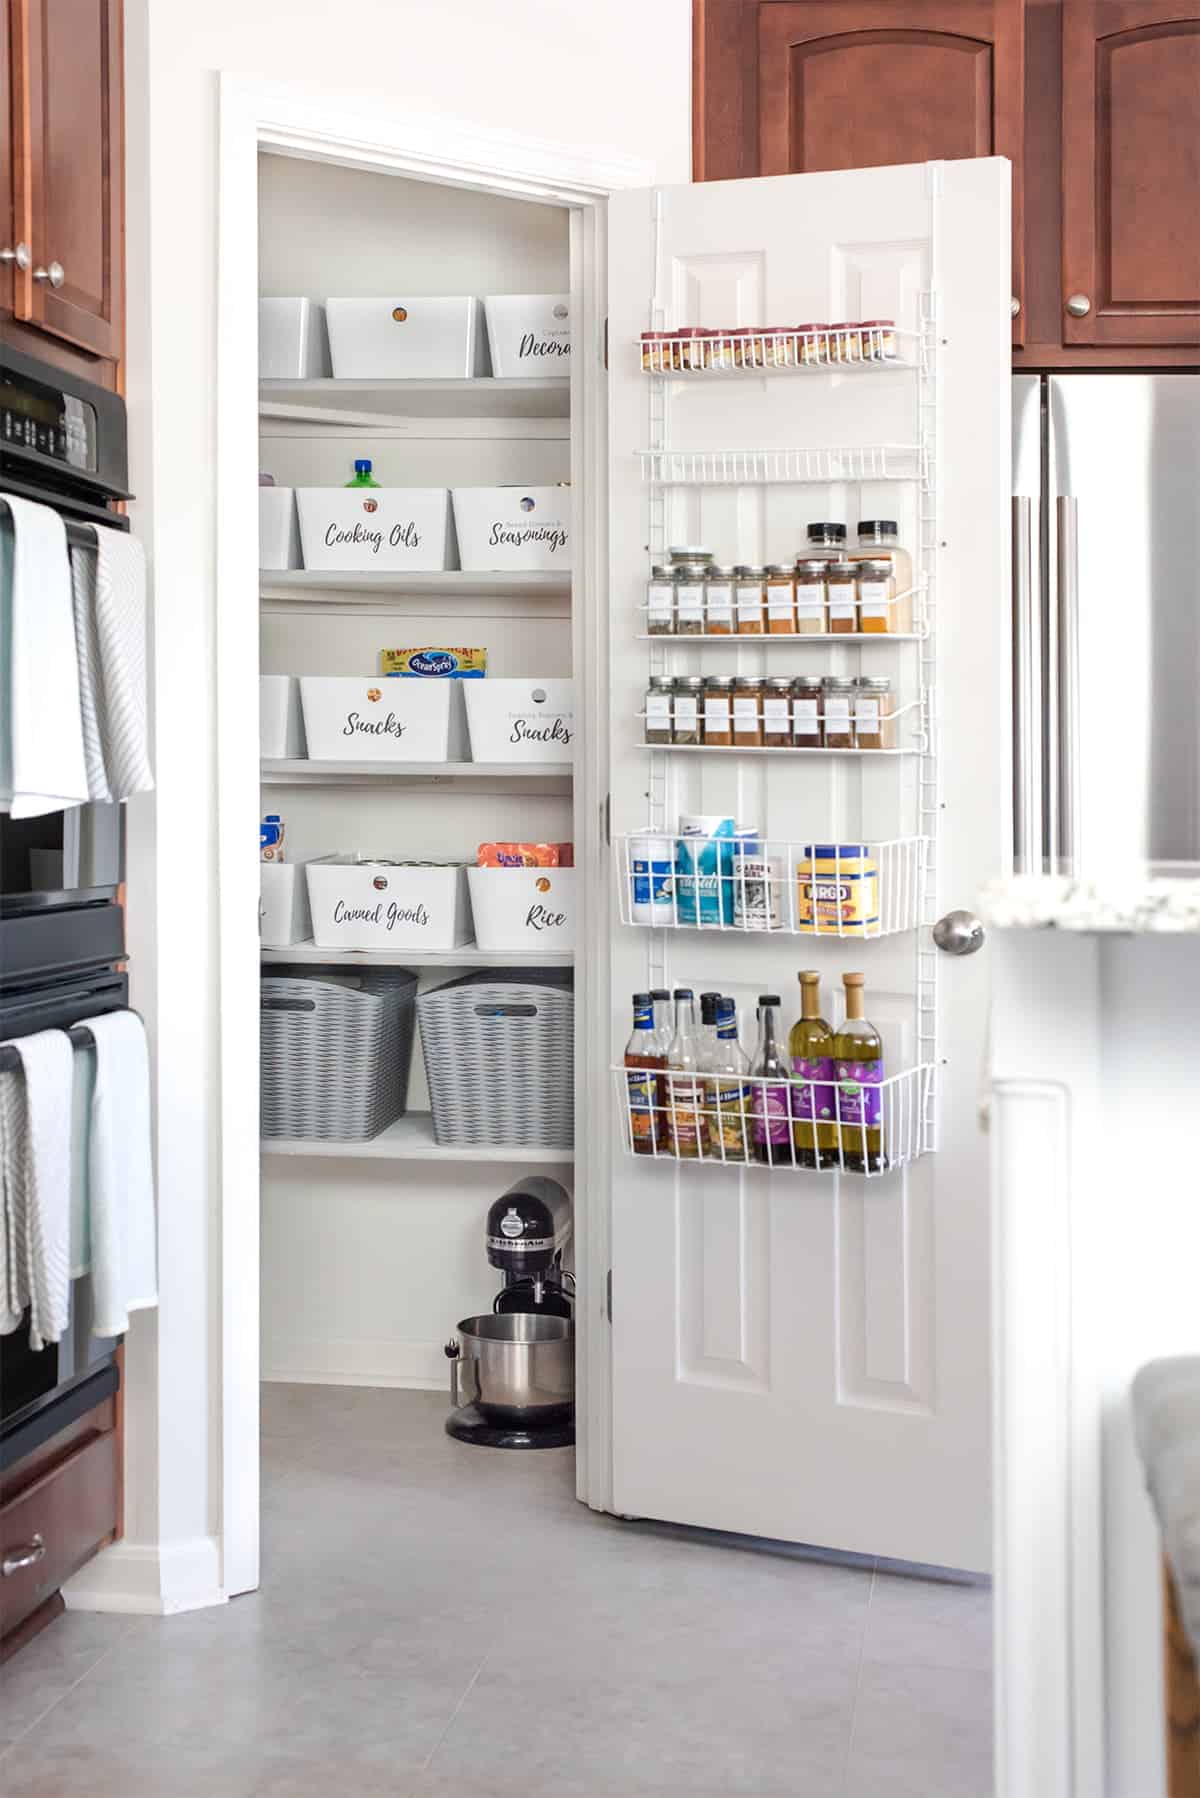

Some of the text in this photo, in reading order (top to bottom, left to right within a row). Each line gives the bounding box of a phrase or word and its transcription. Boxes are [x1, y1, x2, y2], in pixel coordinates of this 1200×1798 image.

[324, 523, 421, 554] Cooking Oils
[488, 522, 569, 553] Seasonings
[343, 712, 407, 738] Snacks
[510, 718, 574, 745] Snacks
[334, 900, 430, 931] Canned Goods
[525, 904, 567, 929] Rice
